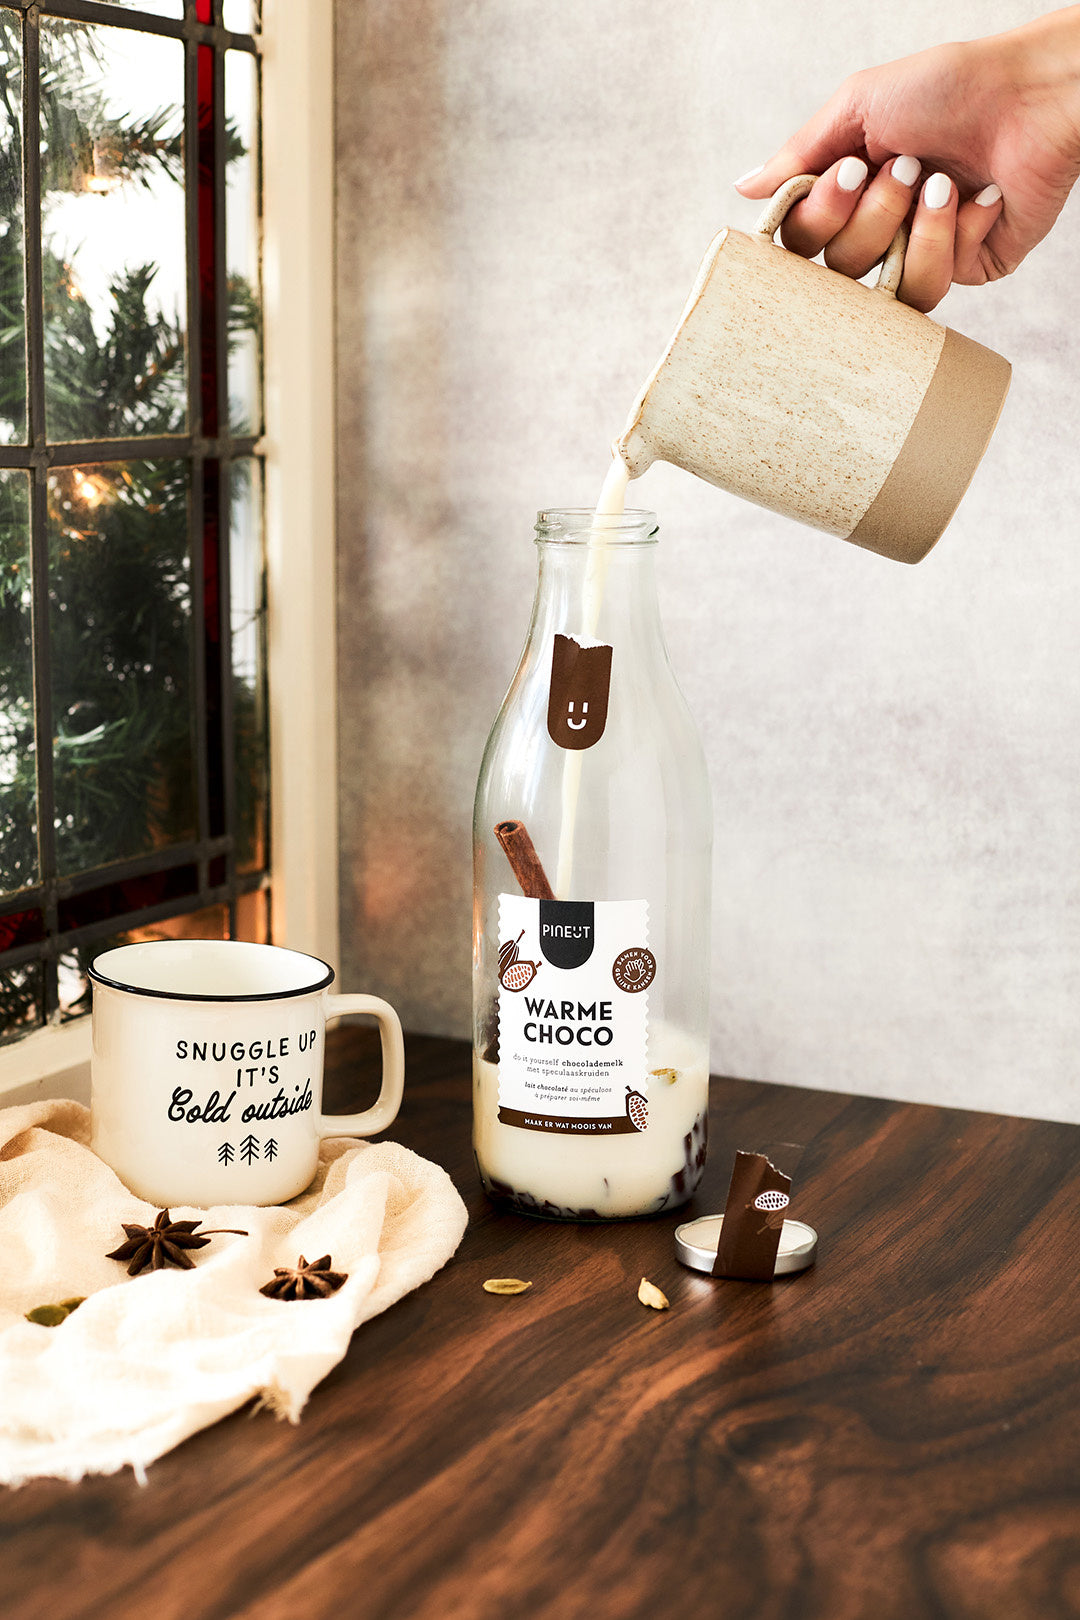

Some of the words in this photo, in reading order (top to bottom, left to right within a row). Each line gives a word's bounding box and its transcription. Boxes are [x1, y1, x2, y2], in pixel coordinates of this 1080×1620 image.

[542, 924, 591, 939] PINEUT
[524, 997, 612, 1021] WARME
[523, 1022, 613, 1046] CHOCO
[176, 1037, 290, 1061] SNUGGLE
[299, 1030, 316, 1052] UP
[530, 1057, 559, 1067] yourself
[562, 1059, 623, 1068] chocolademelk
[236, 1065, 279, 1087] IT'S
[526, 1066, 540, 1074] met
[541, 1067, 610, 1078] speculaaskruiden
[536, 1084, 568, 1093] chocolaté
[580, 1086, 612, 1094] spéculoos
[168, 1086, 237, 1123] Cold
[241, 1078, 312, 1123] outside
[540, 1093, 567, 1101] préparer
[524, 1118, 543, 1127] MAAK
